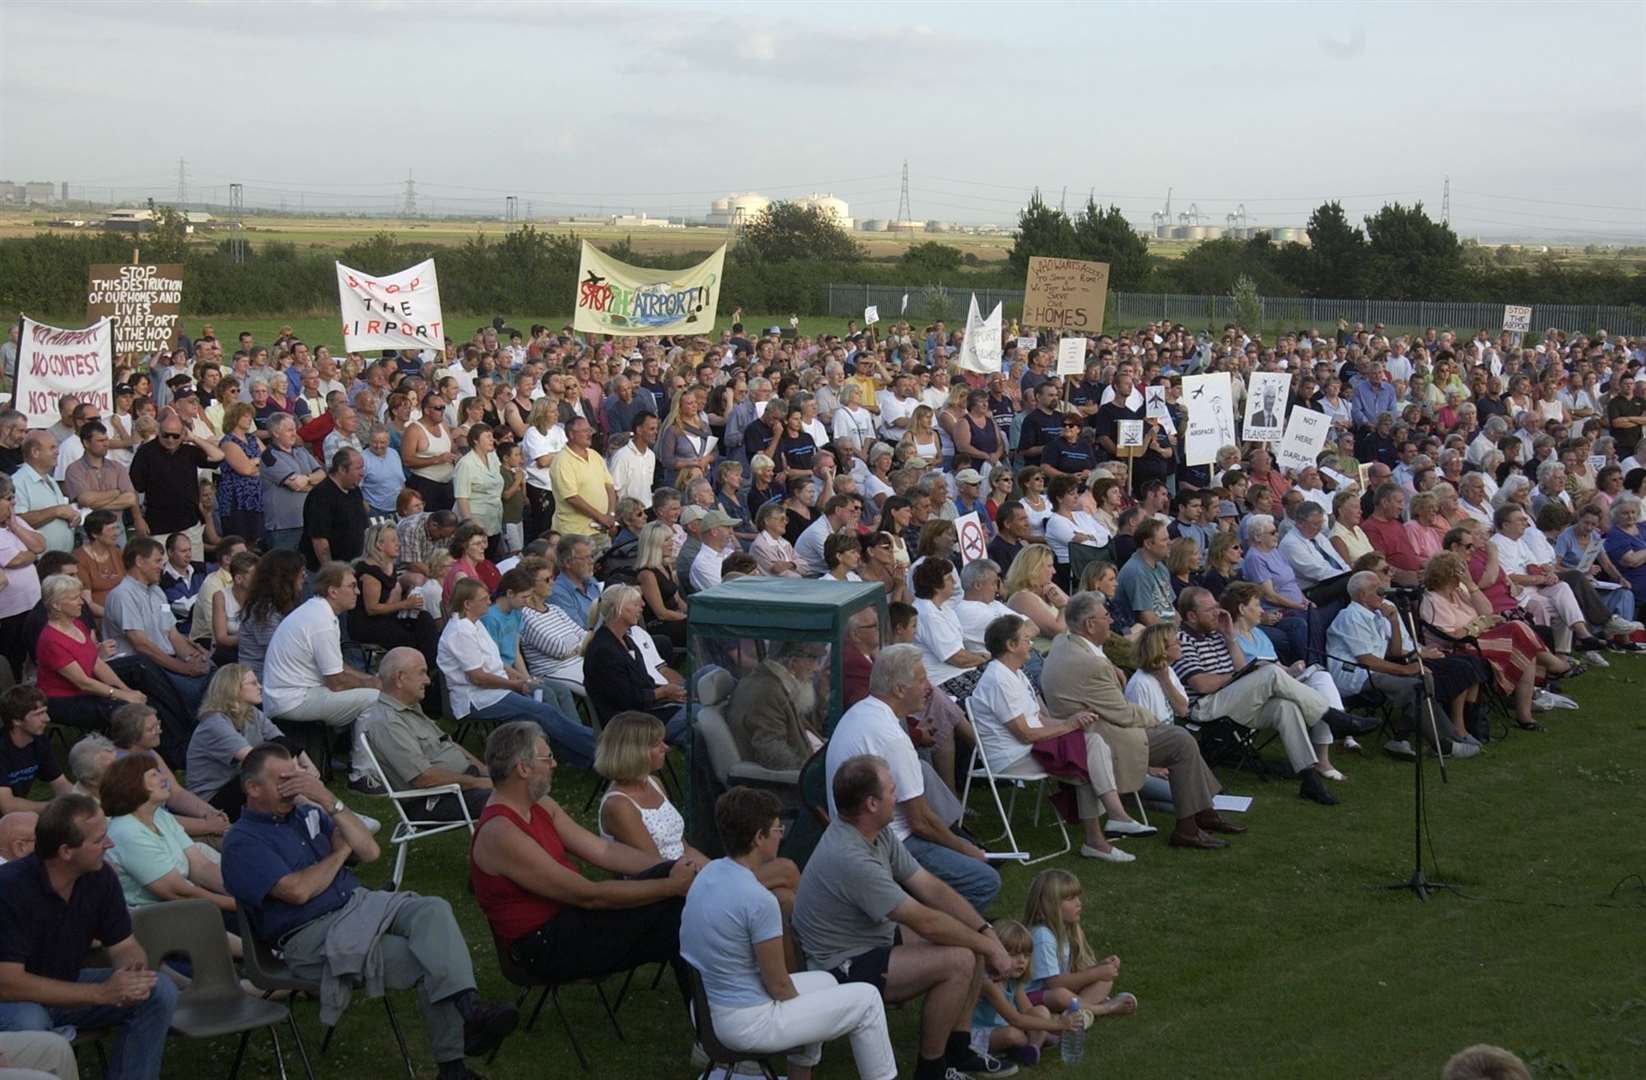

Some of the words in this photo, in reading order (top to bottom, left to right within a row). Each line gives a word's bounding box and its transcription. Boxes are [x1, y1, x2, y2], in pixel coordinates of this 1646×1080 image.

[120, 265, 157, 280] STOP
[92, 280, 121, 291] THIS
[122, 278, 183, 292] DESTRUCTION
[348, 275, 420, 294] STOP
[89, 291, 104, 304] OF
[105, 291, 127, 304] OUR
[127, 291, 157, 304] HOMES
[159, 291, 181, 304] AND
[579, 281, 612, 312] STOP
[115, 302, 152, 315] LIVES
[363, 298, 412, 317] THE
[1507, 306, 1530, 315] STOP
[122, 314, 179, 327] AIRPORT
[1036, 307, 1088, 327] HOMES
[124, 327, 145, 340] THE
[146, 327, 172, 340] HOO
[30, 351, 48, 377] NO
[49, 351, 100, 378] CONTEST
[28, 390, 47, 414] NO
[1303, 416, 1318, 426] NOT
[1295, 434, 1314, 446] HERE
